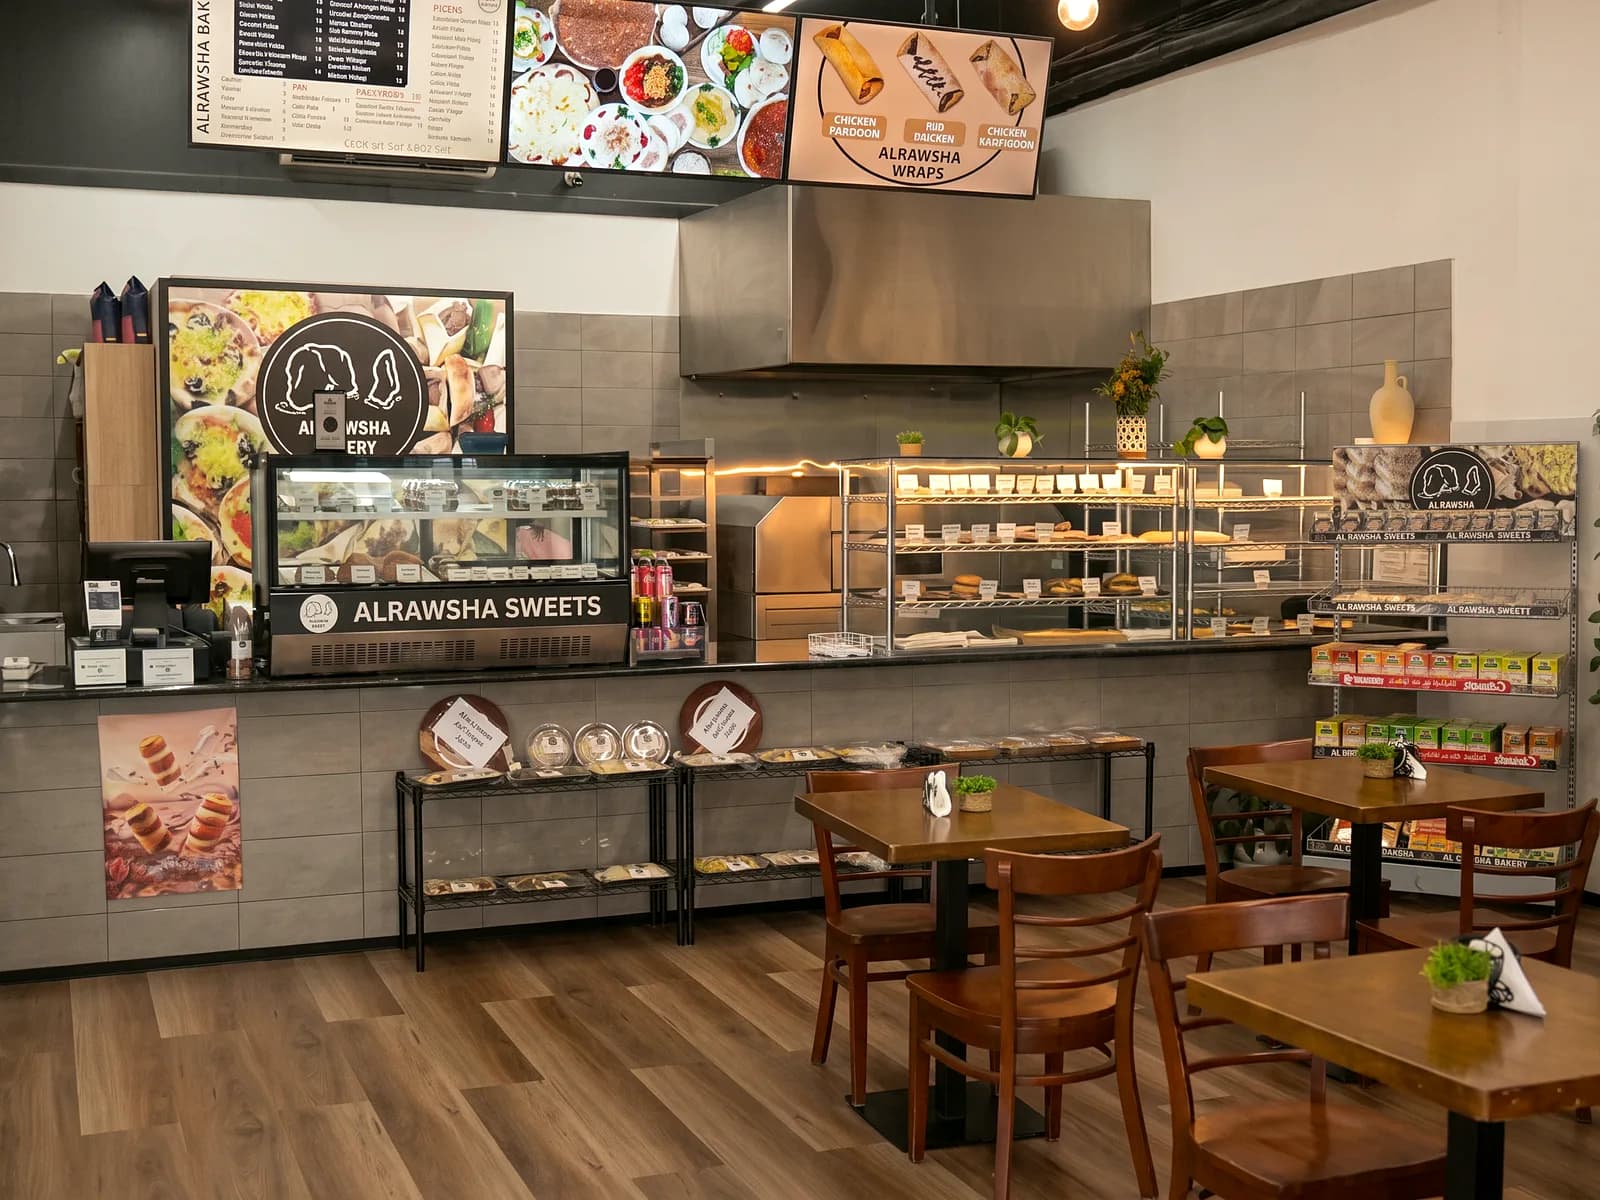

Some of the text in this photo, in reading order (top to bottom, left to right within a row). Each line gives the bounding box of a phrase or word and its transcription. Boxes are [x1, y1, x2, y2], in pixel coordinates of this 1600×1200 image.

[197, 41, 210, 134] ALRAWSHA
[834, 114, 877, 126] CHICKEN
[830, 126, 880, 138] PARDOON
[987, 126, 1027, 138] CHICKEN
[878, 146, 960, 164] ALRAWSHA
[892, 164, 944, 180] WRAPS
[1429, 500, 1474, 509] ALRAWSHA
[1497, 531, 1531, 539] SWEETS
[354, 596, 602, 622] ALRAWSHA SWEETS
[1384, 604, 1416, 612] SWEETS
[1458, 606, 1496, 614] RAWSHA
[1333, 844, 1344, 852] AL
[1443, 854, 1454, 862] AL
